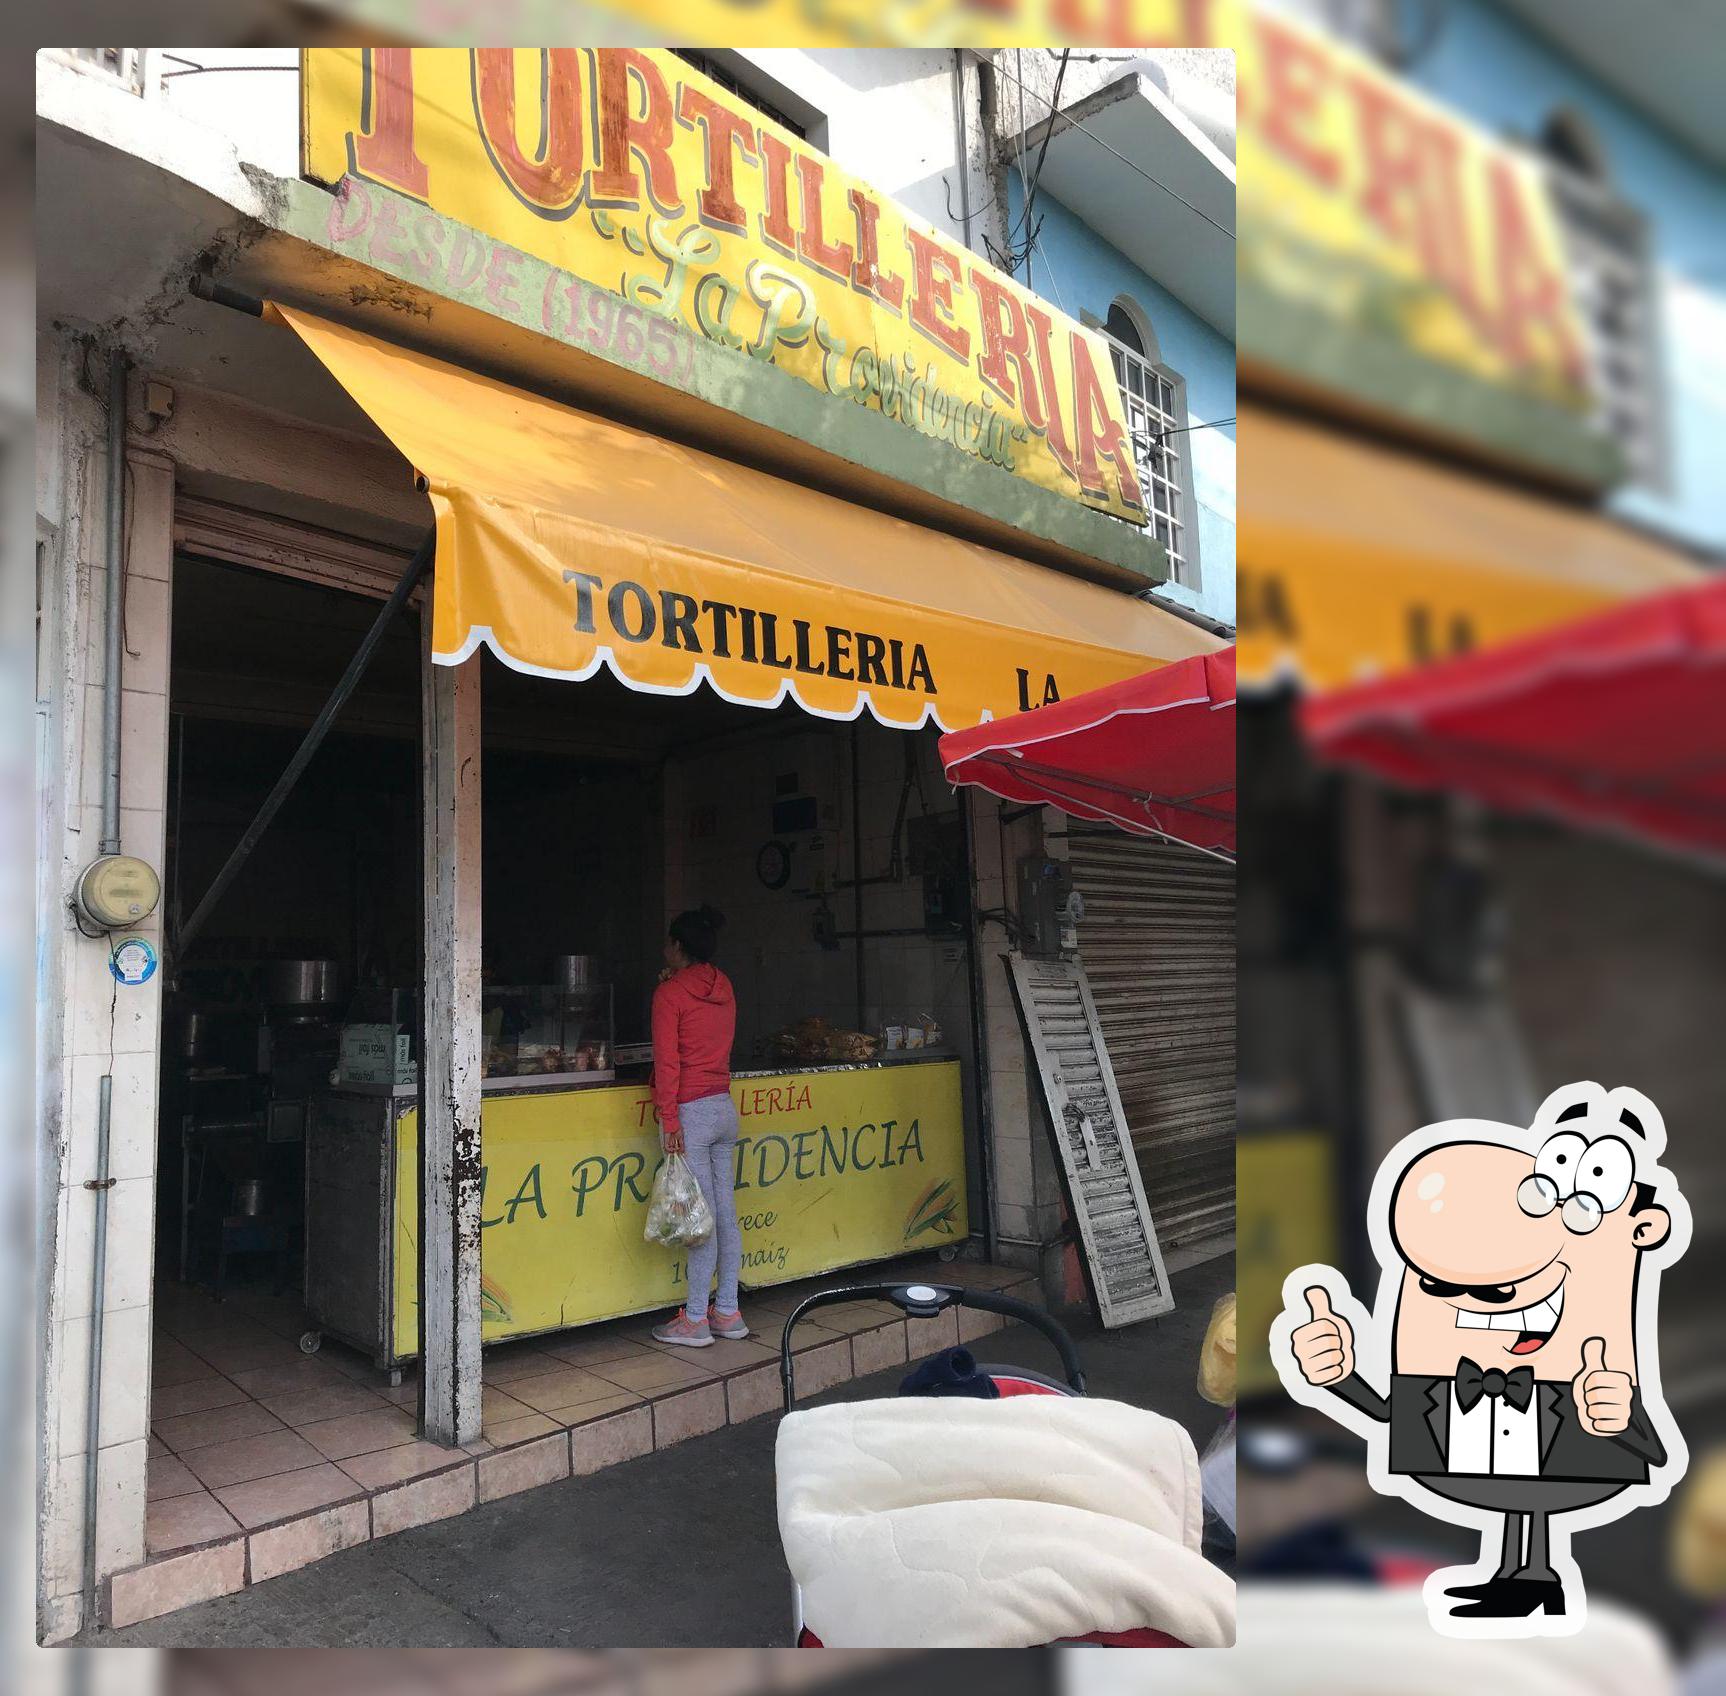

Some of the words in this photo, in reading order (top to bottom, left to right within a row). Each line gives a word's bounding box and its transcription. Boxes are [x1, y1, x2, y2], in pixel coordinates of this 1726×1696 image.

[326, 178, 524, 314] DESDE
[562, 569, 938, 695] TORTILLERIA
[1016, 667, 1061, 713] LA
[480, 1163, 548, 1229] LA
